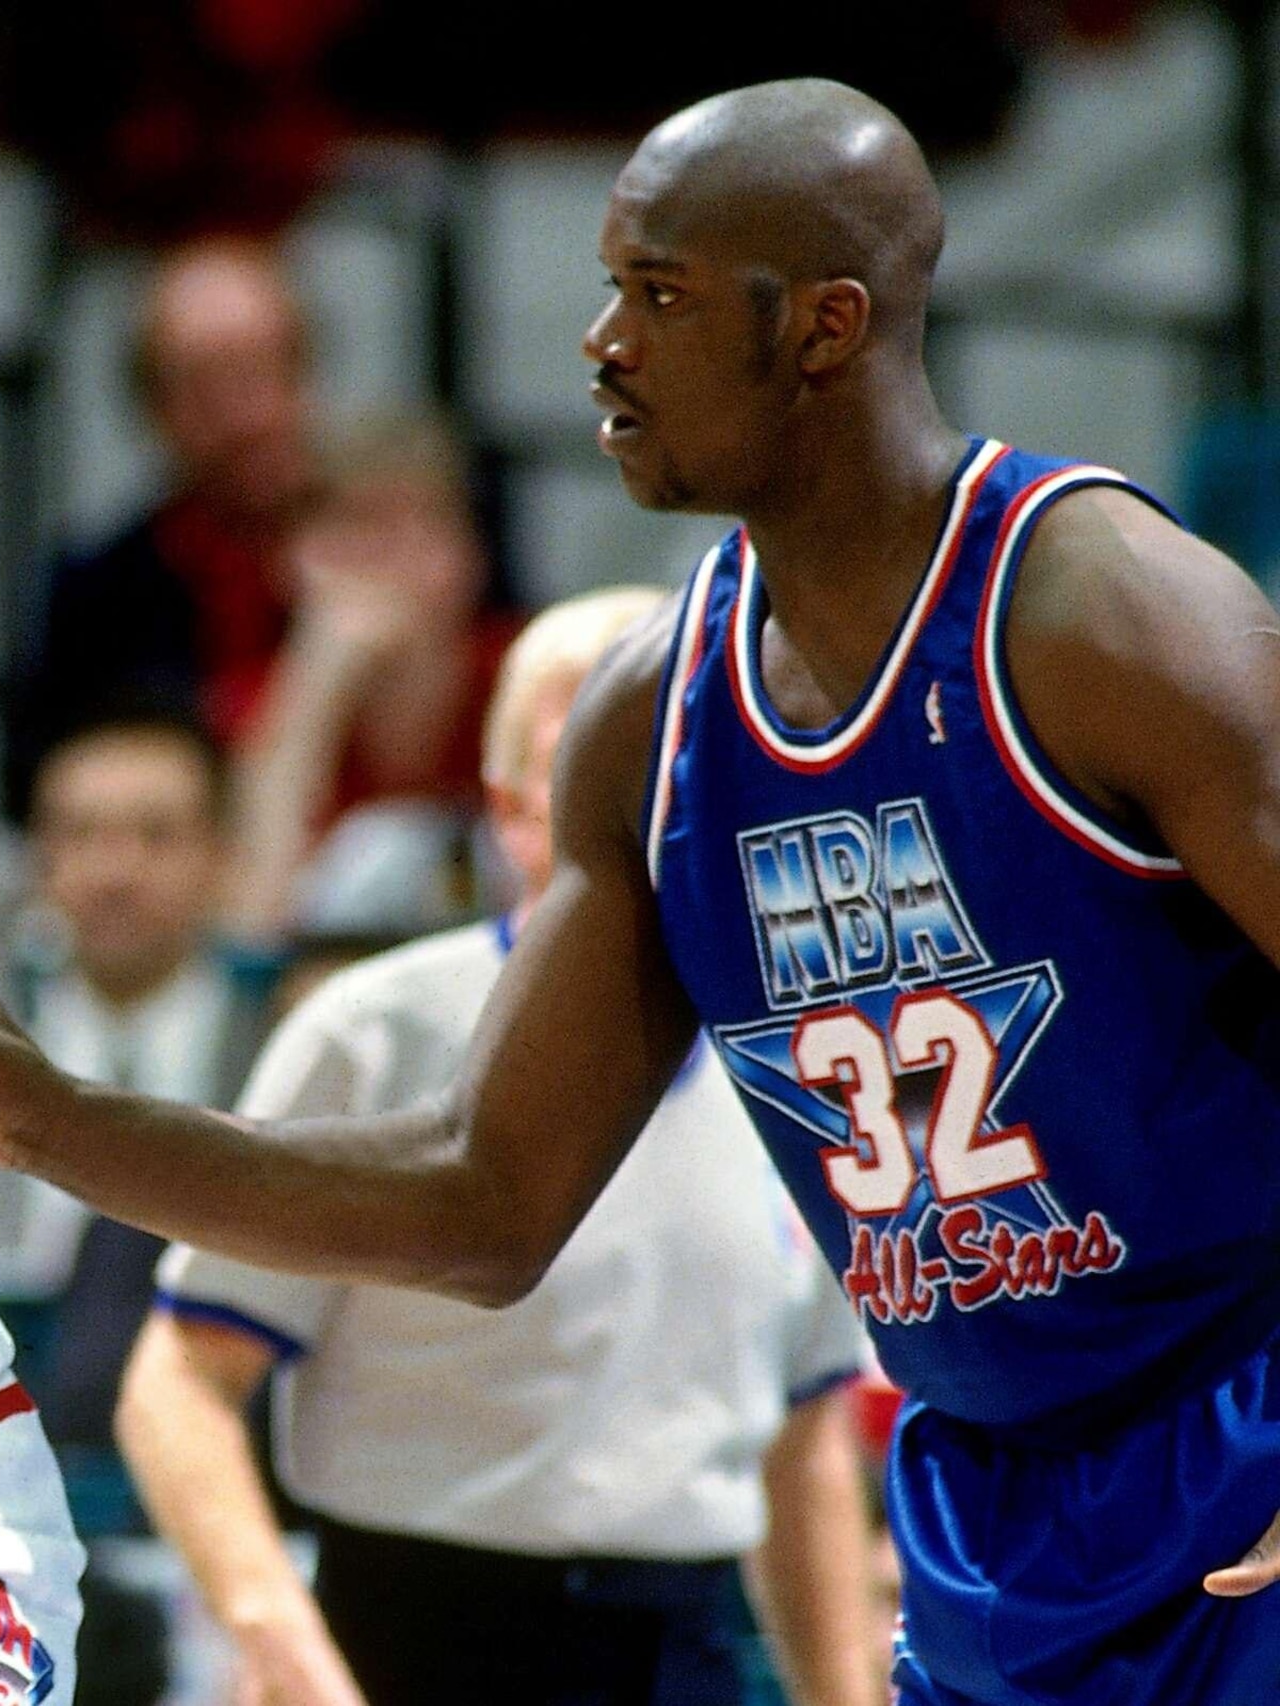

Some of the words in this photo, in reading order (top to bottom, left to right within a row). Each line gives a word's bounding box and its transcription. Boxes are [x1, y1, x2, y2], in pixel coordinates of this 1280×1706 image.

[736, 797, 993, 1010] NBA
[790, 986, 1047, 1218] 32
[843, 1204, 1125, 1324] All-Stars
